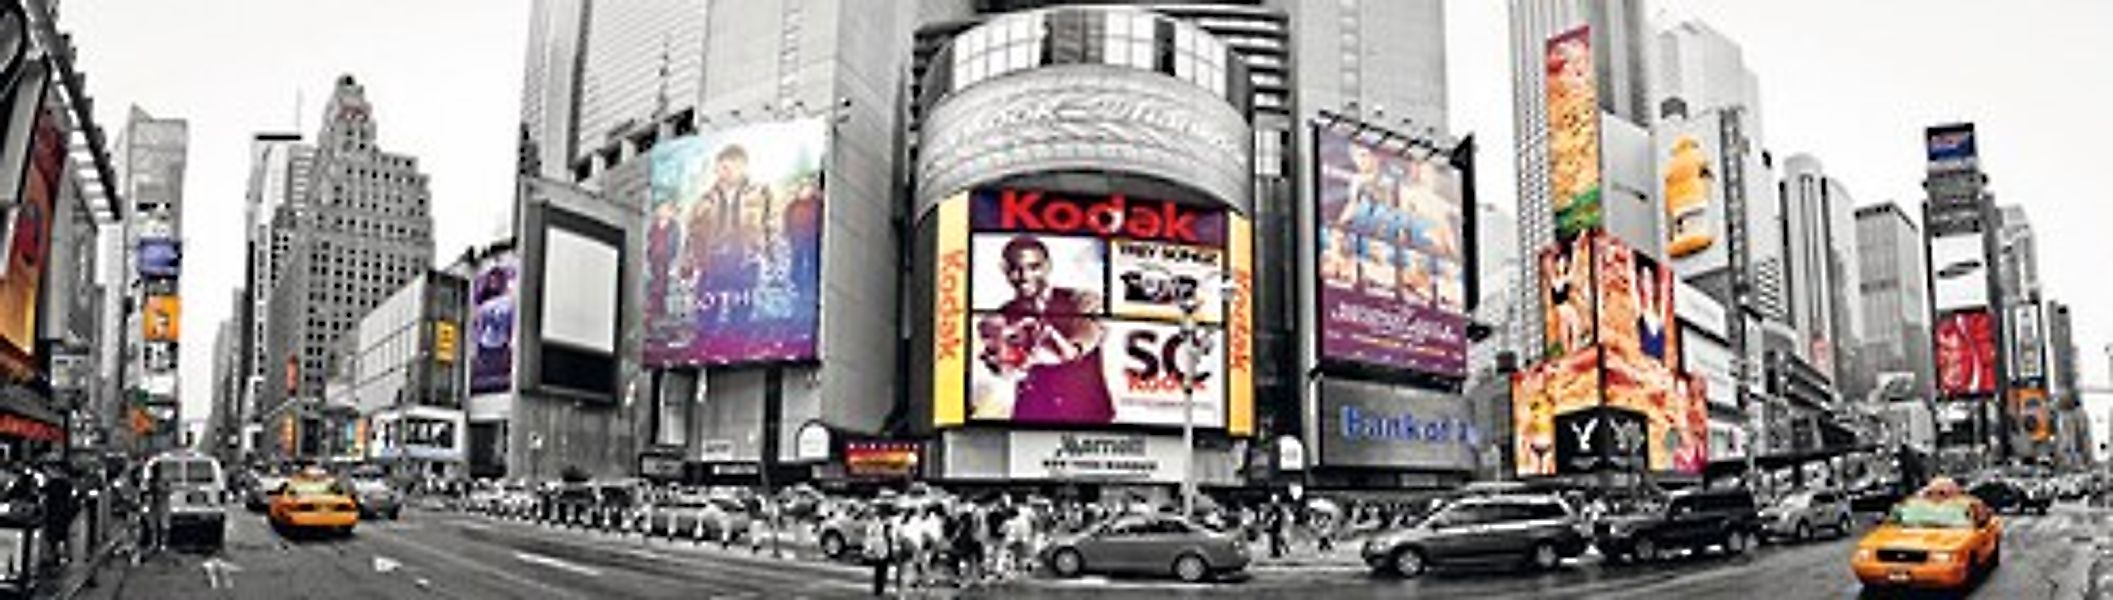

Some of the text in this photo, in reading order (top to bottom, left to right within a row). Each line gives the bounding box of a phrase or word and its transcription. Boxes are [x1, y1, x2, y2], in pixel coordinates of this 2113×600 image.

[1001, 189, 1200, 241] Kodak
[938, 250, 965, 360] Kodak
[1340, 405, 1424, 441] Bank
